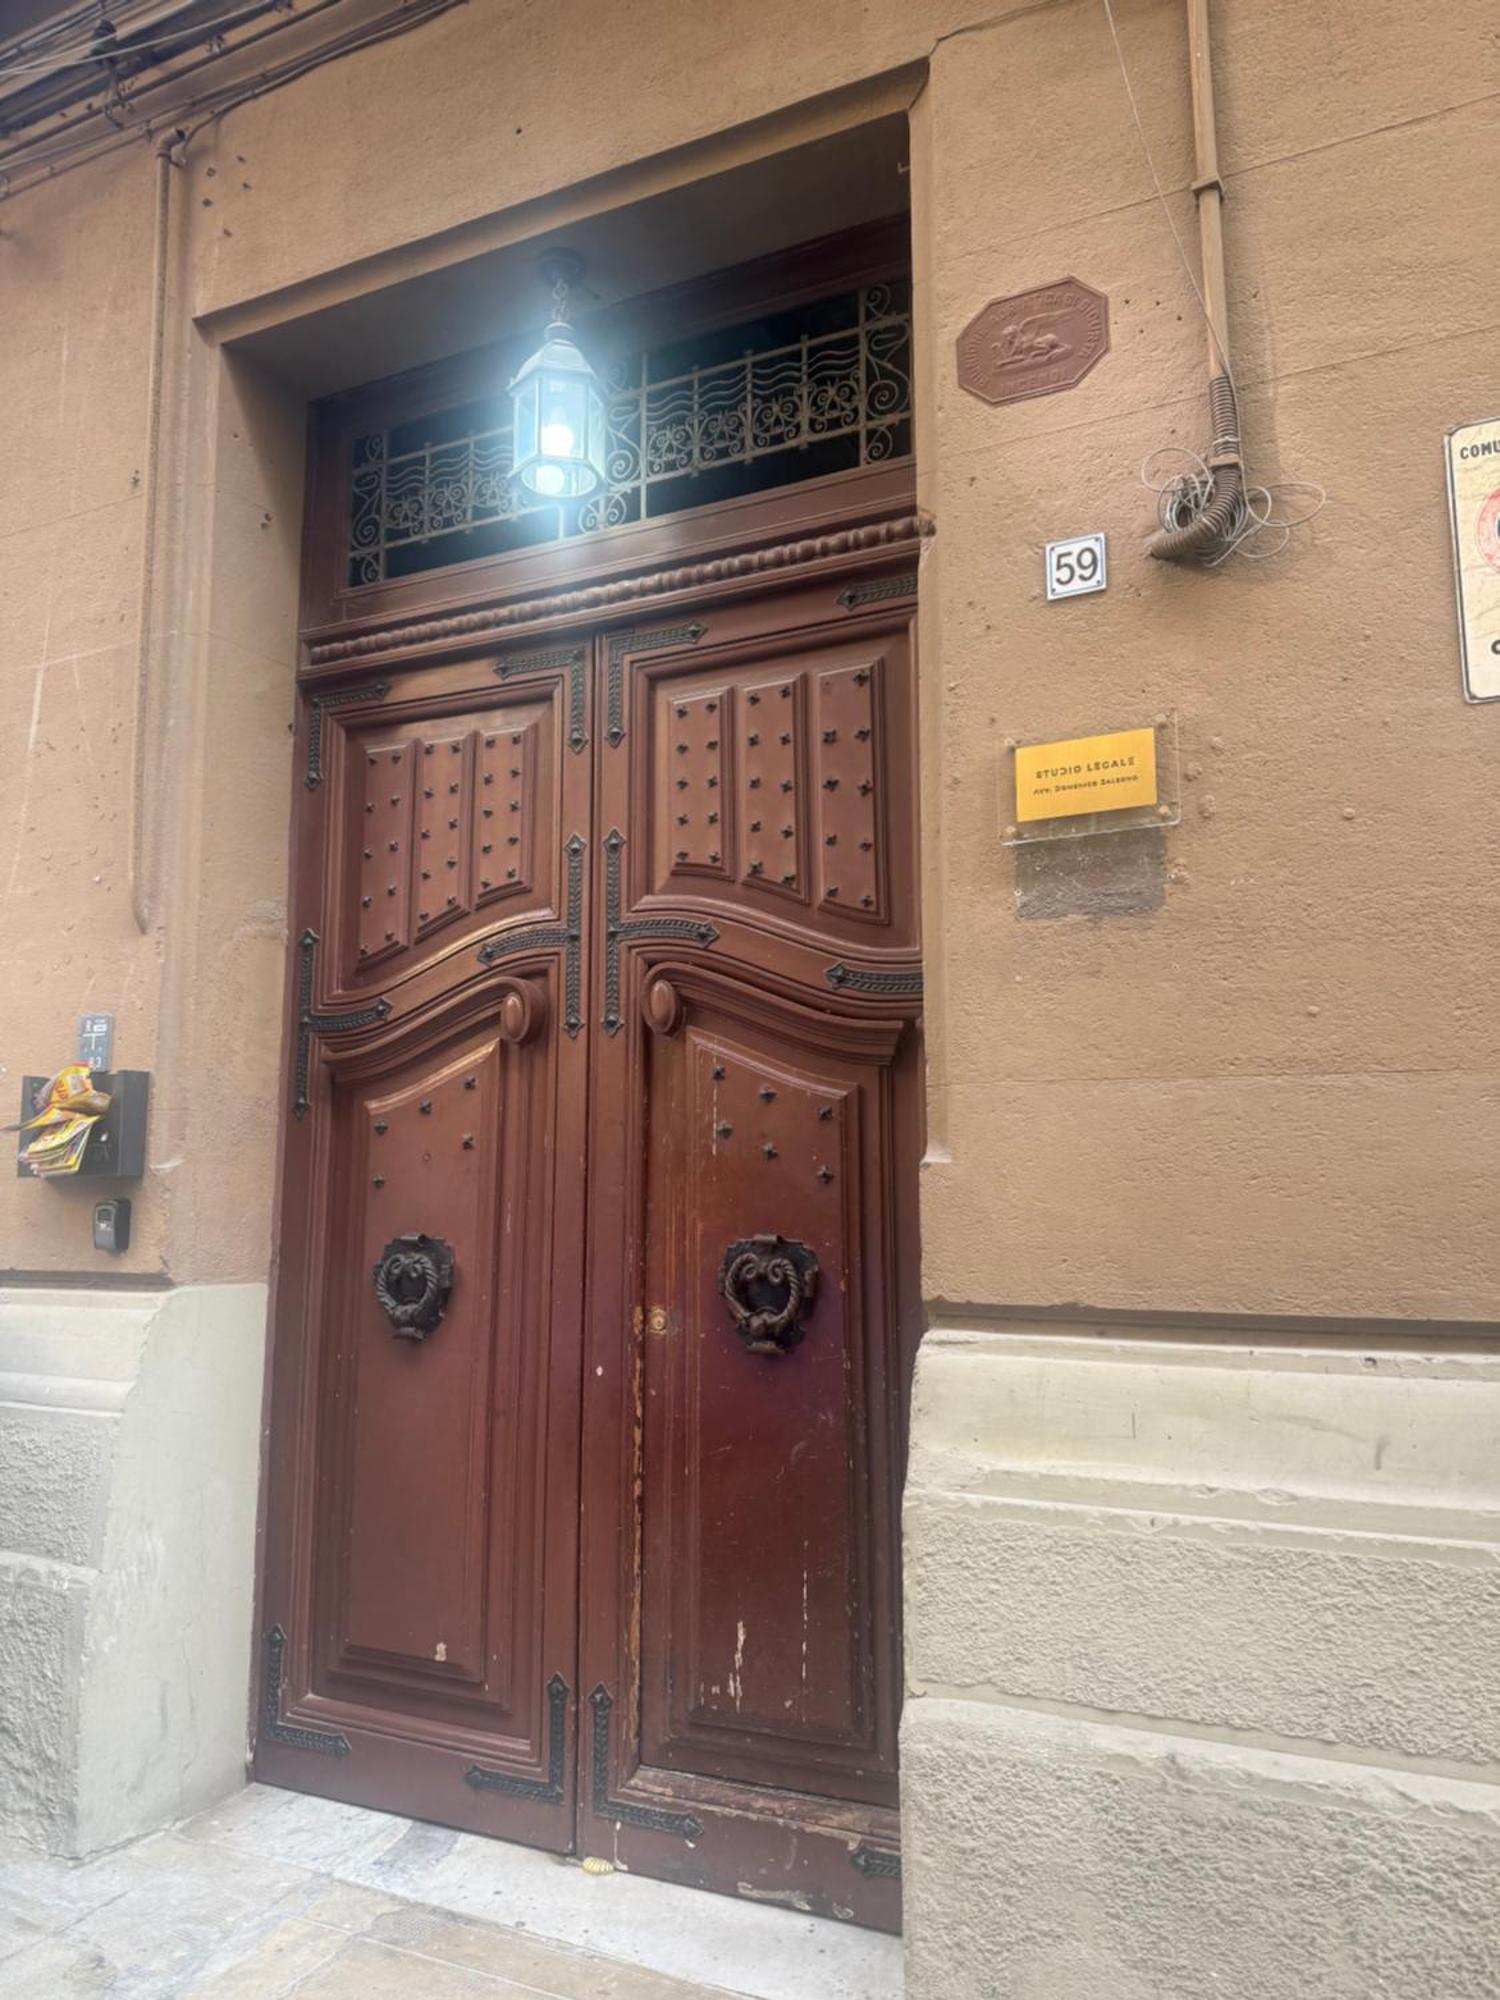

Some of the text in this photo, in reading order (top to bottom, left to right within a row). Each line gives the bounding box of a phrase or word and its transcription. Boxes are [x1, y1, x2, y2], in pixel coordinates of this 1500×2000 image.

[1055, 547, 1099, 586] 59
[1035, 757, 1135, 779] STUDIO LEGALE
